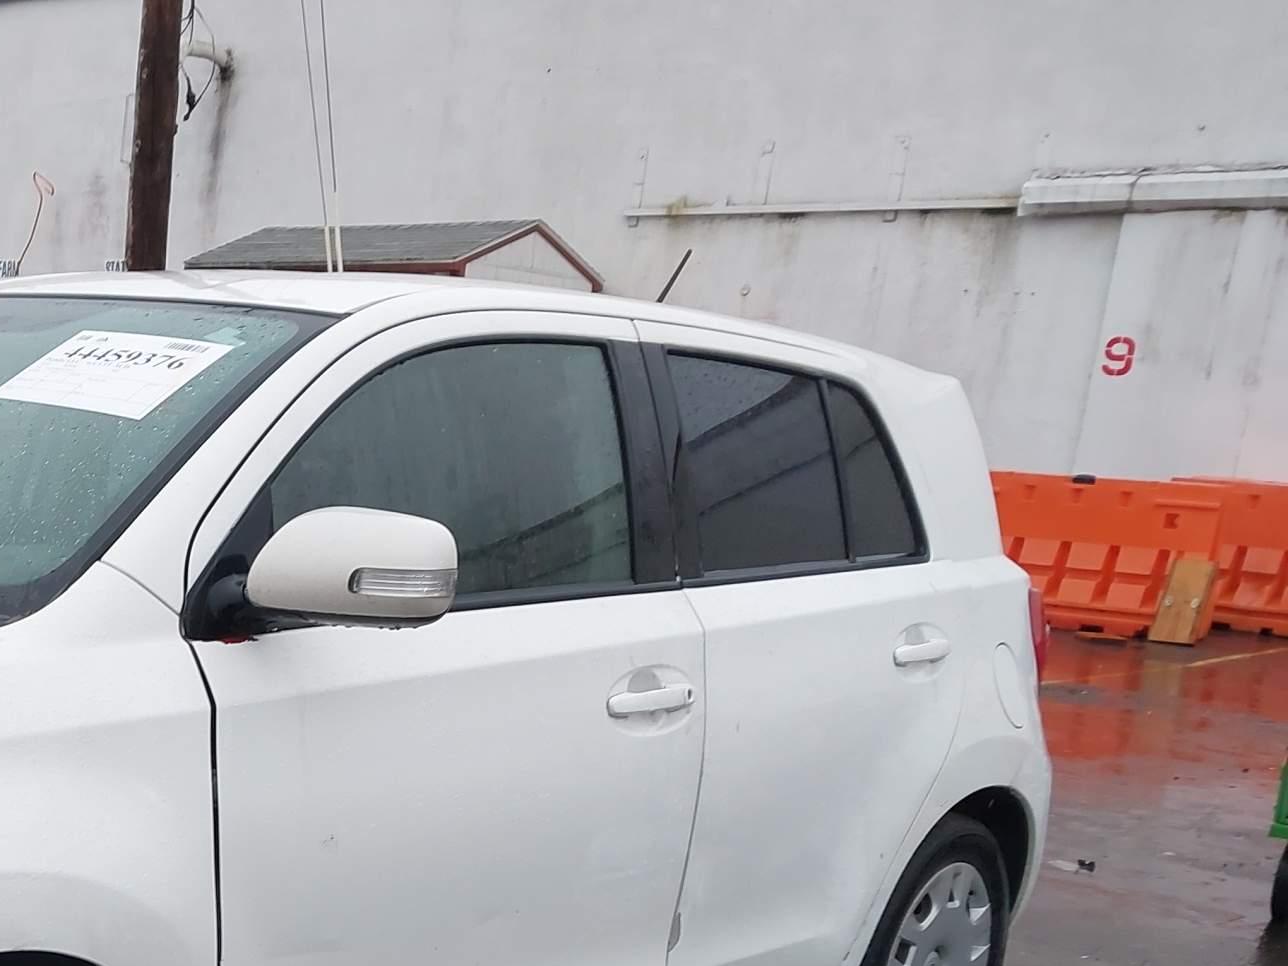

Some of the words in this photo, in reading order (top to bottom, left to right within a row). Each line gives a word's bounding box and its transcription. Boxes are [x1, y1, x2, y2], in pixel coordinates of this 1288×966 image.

[105, 260, 128, 272] STAT
[63, 346, 191, 370] 44459376
[1101, 335, 1136, 376] 9
